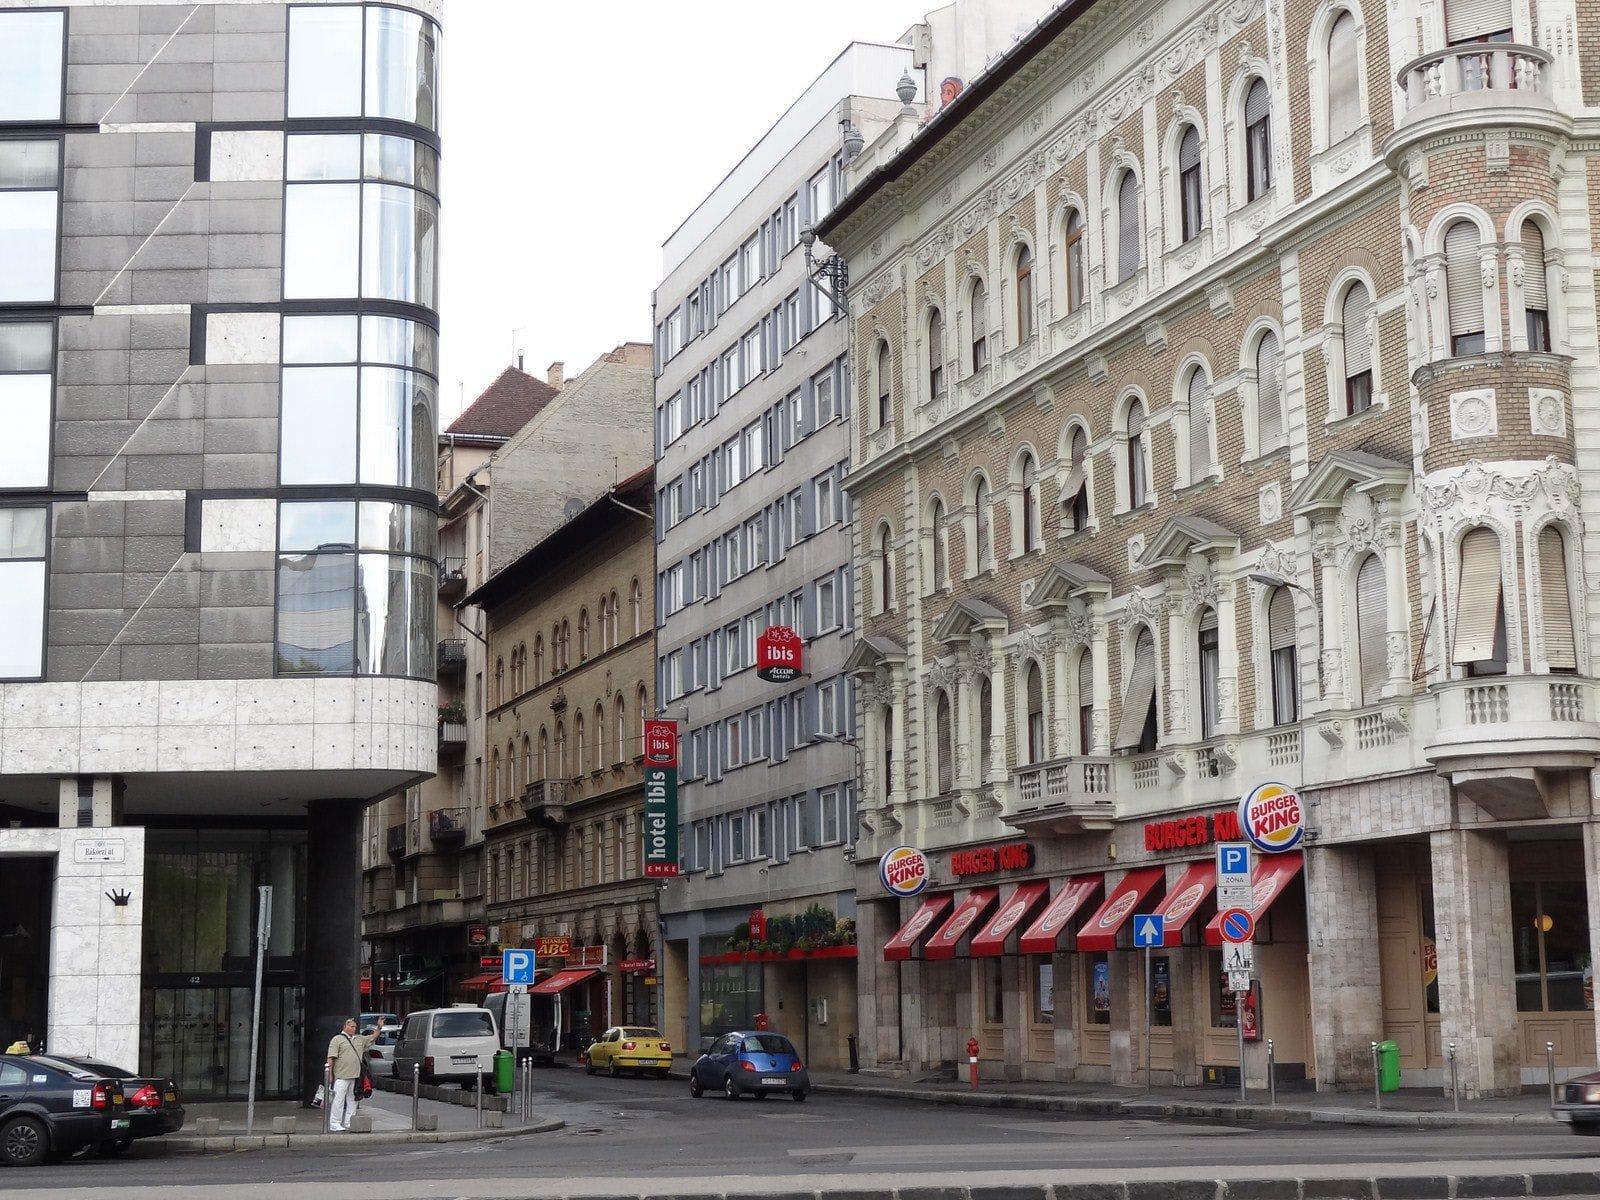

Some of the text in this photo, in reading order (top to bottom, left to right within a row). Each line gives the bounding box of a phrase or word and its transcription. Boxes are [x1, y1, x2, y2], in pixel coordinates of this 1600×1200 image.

[767, 645, 794, 660] ibis
[653, 739, 670, 750] ibis
[648, 771, 666, 804] ibis
[1251, 794, 1297, 821] BURGER
[1144, 816, 1208, 852] BURGER
[1253, 806, 1301, 839] KING
[648, 812, 666, 859] hotel
[647, 865, 677, 873] EMKE
[887, 855, 922, 874] BURGER
[951, 847, 995, 875] BURGER
[1227, 850, 1241, 871] P
[889, 863, 925, 886] KING
[537, 943, 569, 955] ABC
[509, 952, 529, 980] P
